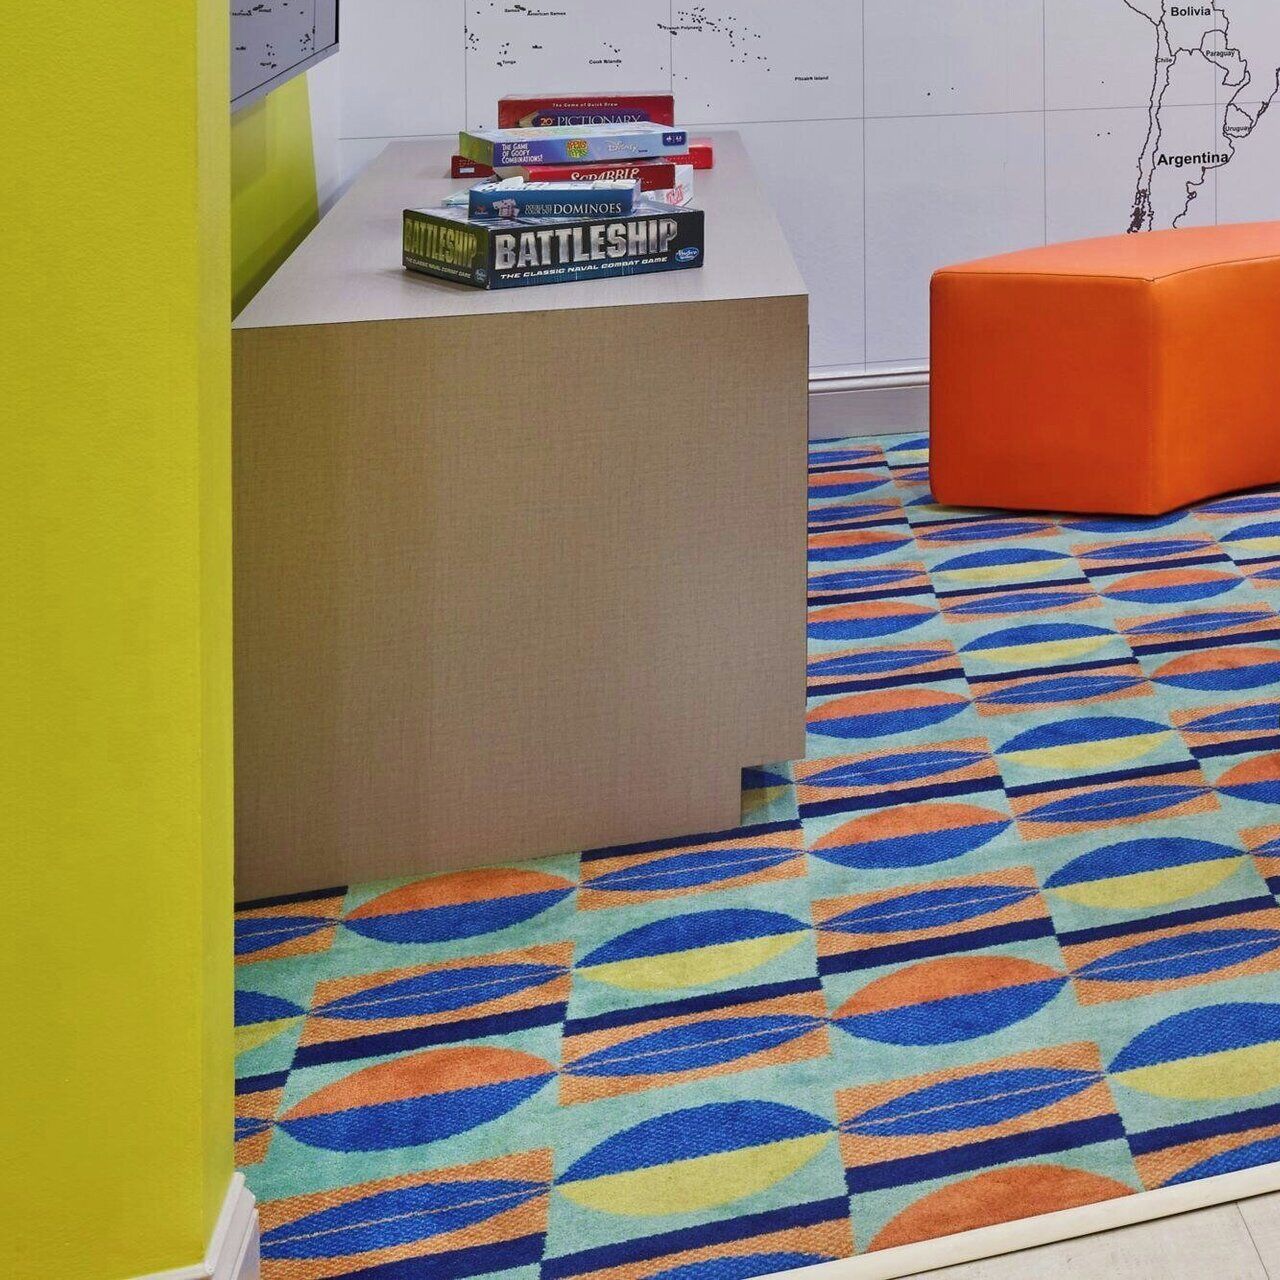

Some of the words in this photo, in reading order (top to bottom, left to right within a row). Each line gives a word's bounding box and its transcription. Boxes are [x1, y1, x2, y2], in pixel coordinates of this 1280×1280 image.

[1171, 6, 1212, 17] Bolivia
[1206, 49, 1235, 58] Paraguay
[558, 115, 640, 126] PICTIONARY
[501, 142, 512, 150] THE
[512, 142, 528, 150] GAME
[502, 150, 511, 158] OF
[512, 149, 530, 157] GOOFY
[1157, 152, 1229, 167] Argentina
[553, 202, 622, 215] DOMINOES
[404, 218, 477, 268] BATTLESHIP
[494, 218, 679, 271] BATTLESHIP
[522, 269, 565, 279] CLASSIC
[567, 264, 599, 273] NAVAL
[601, 260, 639, 269] COMBAT
[641, 257, 668, 265] GAME
